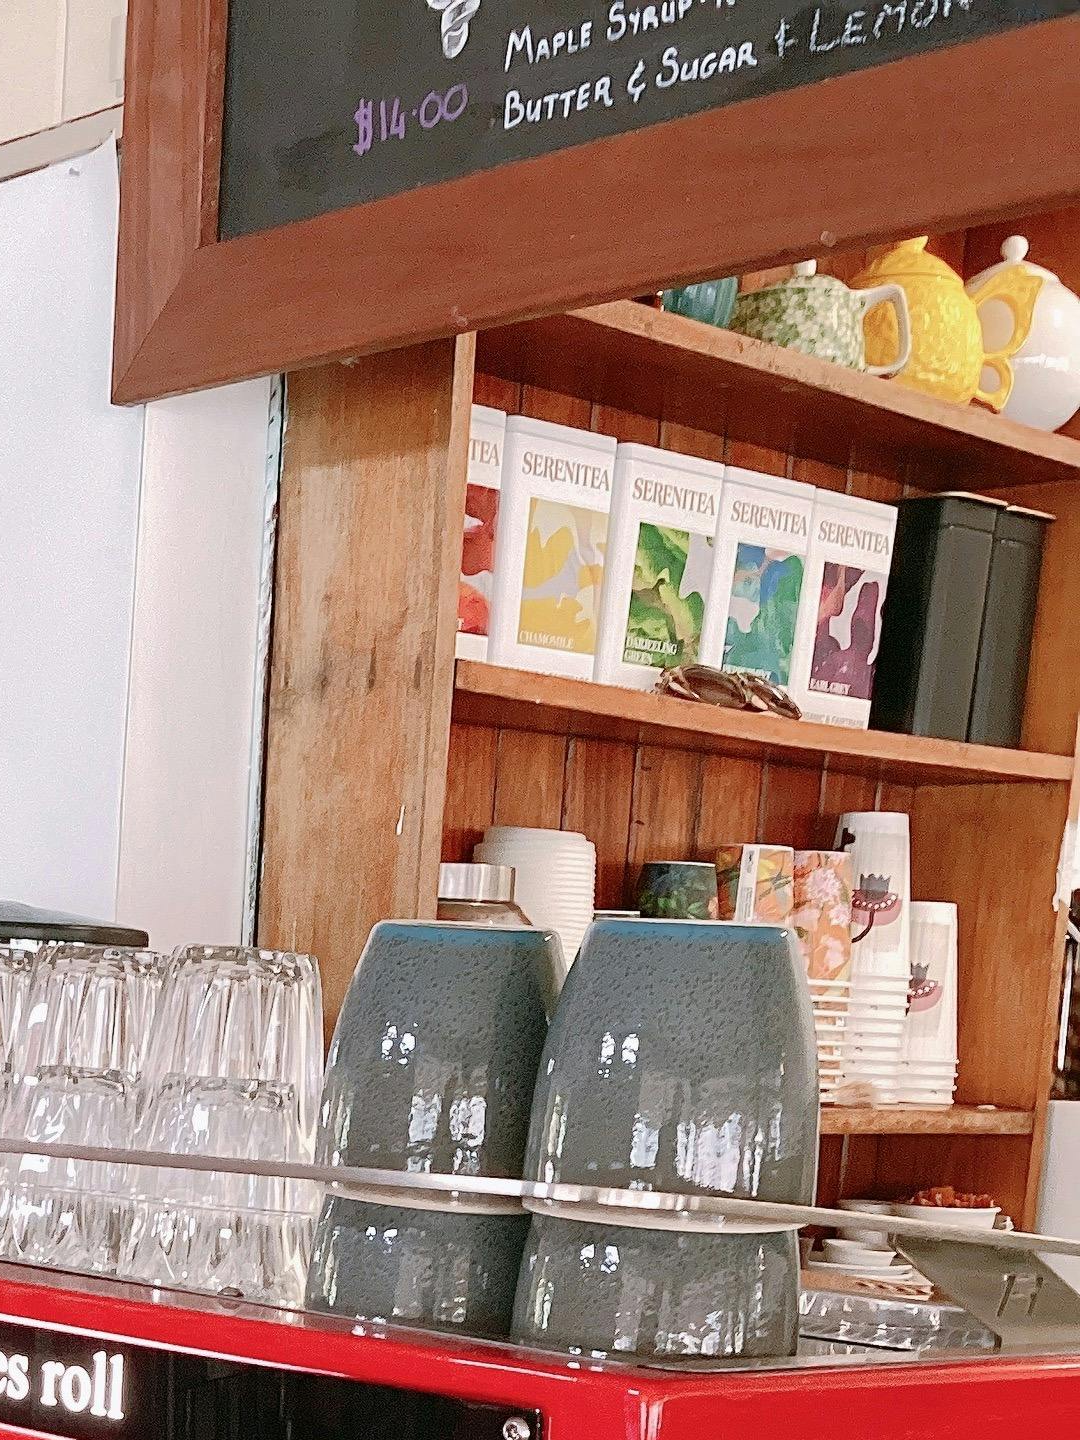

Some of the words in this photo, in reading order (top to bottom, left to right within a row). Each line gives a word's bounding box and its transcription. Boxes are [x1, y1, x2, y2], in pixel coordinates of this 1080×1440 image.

[505, 20, 593, 72] MAPLE
[503, 75, 614, 130] BUTTER
[626, 59, 647, 103] &
[655, 42, 758, 88] SUGAR
[521, 451, 611, 491] SERENITEA
[632, 477, 716, 516] SERENITEA
[730, 500, 808, 537] SERENITEA
[818, 519, 890, 555] SERENITEA
[40, 1350, 125, 1420] roll
